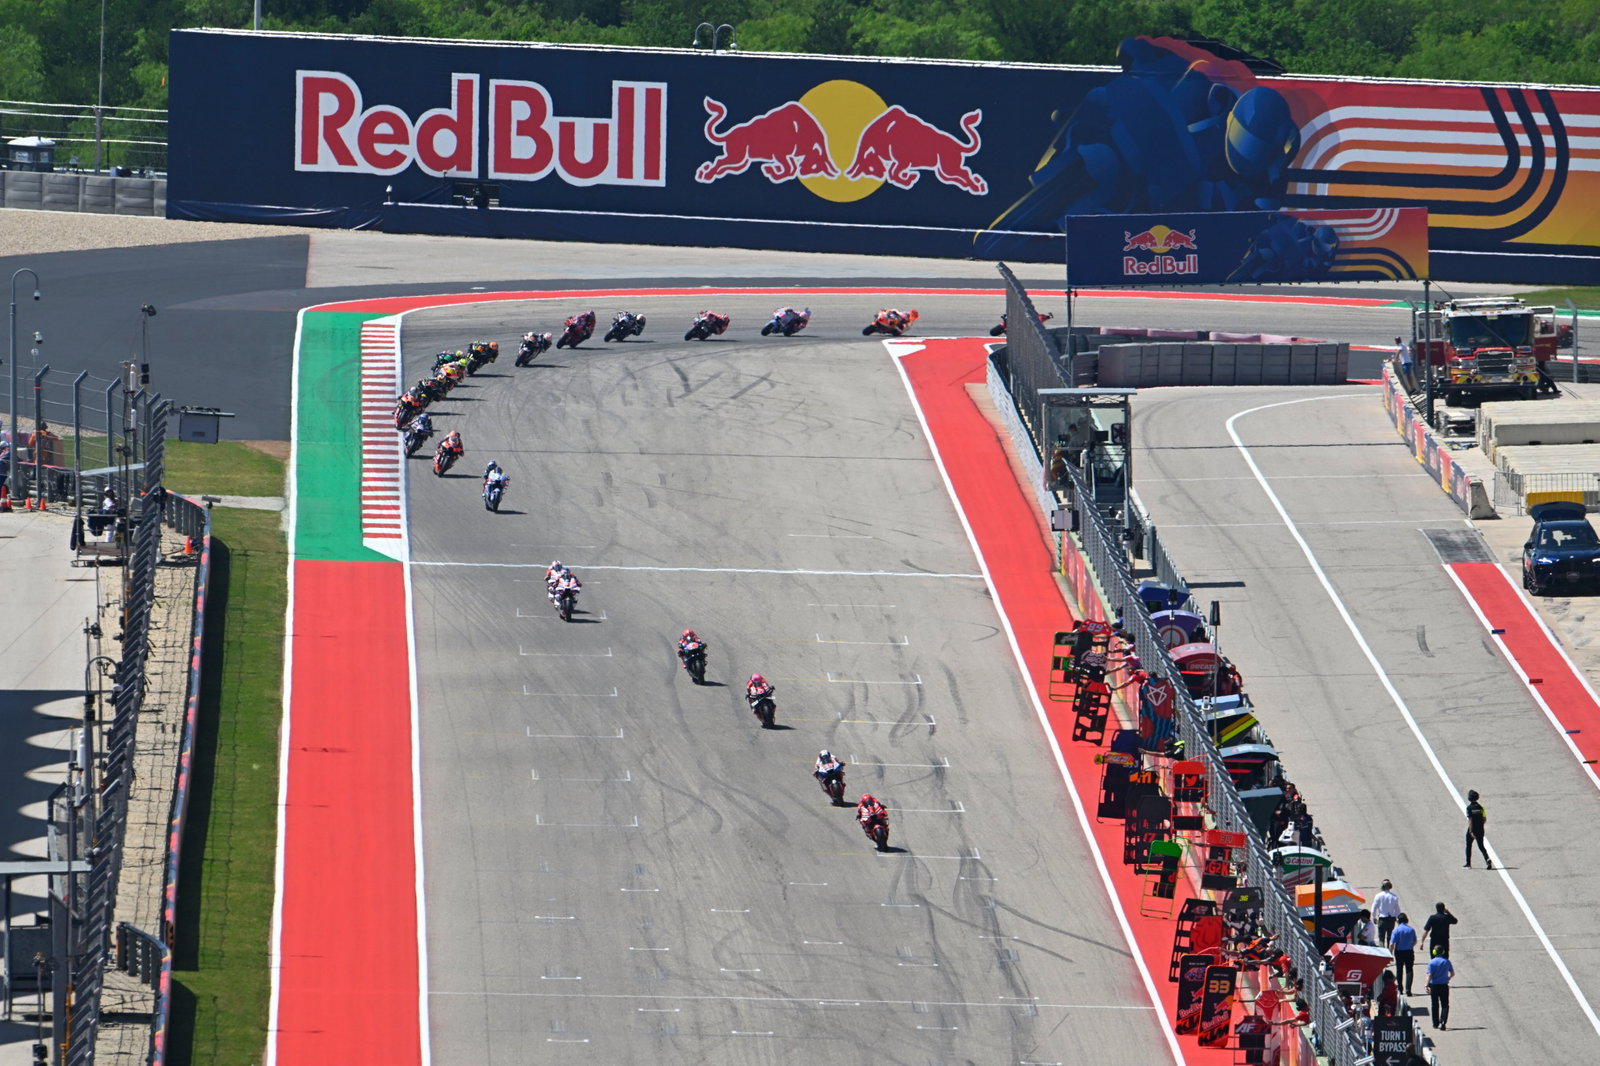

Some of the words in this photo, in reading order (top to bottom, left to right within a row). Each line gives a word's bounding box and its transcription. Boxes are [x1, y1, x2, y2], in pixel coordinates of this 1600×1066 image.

[299, 73, 476, 175] Red
[492, 77, 664, 183] Bull
[1124, 256, 1160, 275] Red
[1162, 255, 1197, 274] Bull
[1208, 980, 1231, 993] 33
[1380, 1030, 1401, 1041] TURN
[1402, 1030, 1406, 1041] 1
[1379, 1041, 1407, 1052] BYPASS
